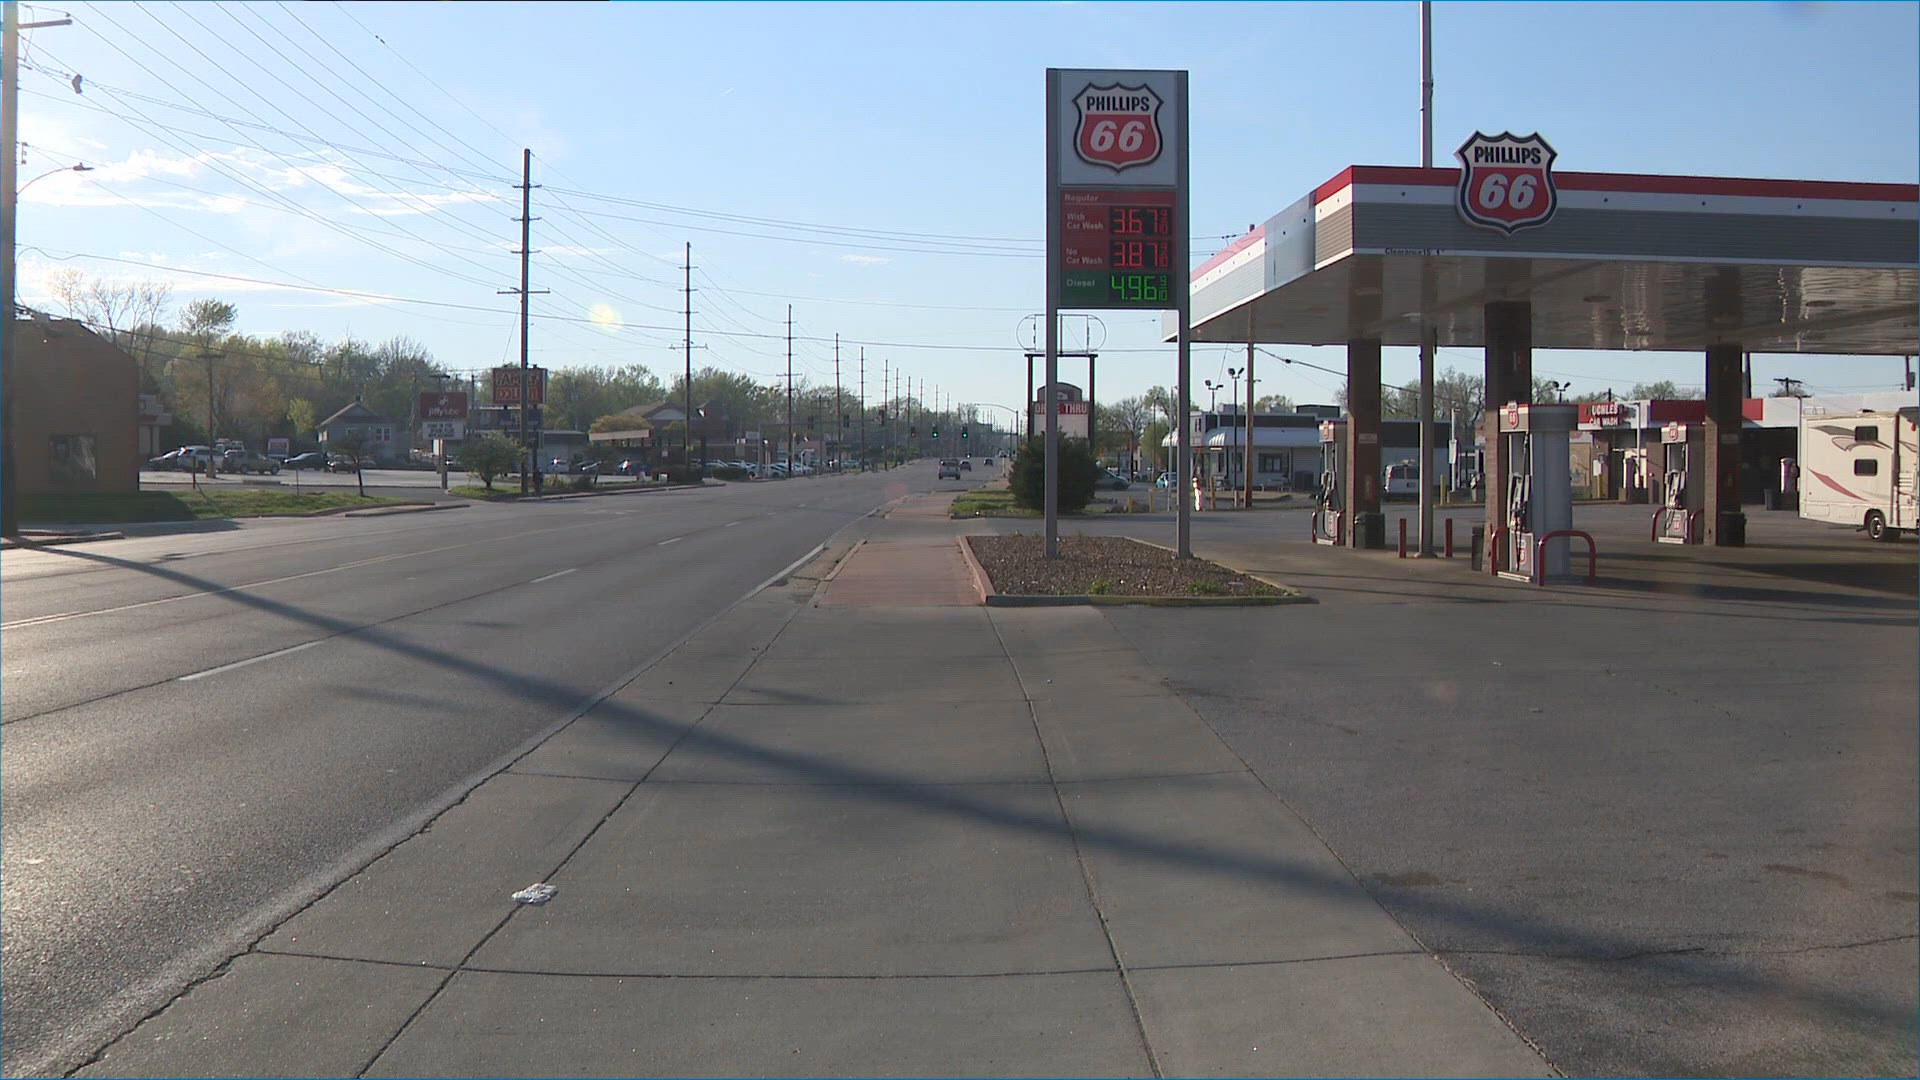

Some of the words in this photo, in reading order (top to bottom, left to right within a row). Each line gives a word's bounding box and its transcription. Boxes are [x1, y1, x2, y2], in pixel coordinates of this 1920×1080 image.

[1086, 96, 1150, 111] PHILLIPS
[1089, 120, 1146, 152] 66
[1474, 146, 1541, 164] PHILLIPS
[1478, 173, 1538, 209] 66
[1064, 193, 1099, 202] Regular
[1066, 212, 1086, 221] With
[1066, 222, 1080, 230] Car
[1082, 222, 1104, 230] Wash
[1066, 248, 1078, 256] No
[1384, 247, 1423, 256] Clearance
[1066, 257, 1080, 265] Car
[1082, 257, 1103, 265] Wash
[1066, 279, 1095, 287] Diesel
[428, 407, 443, 417] jiffy
[1064, 402, 1087, 414] THRU
